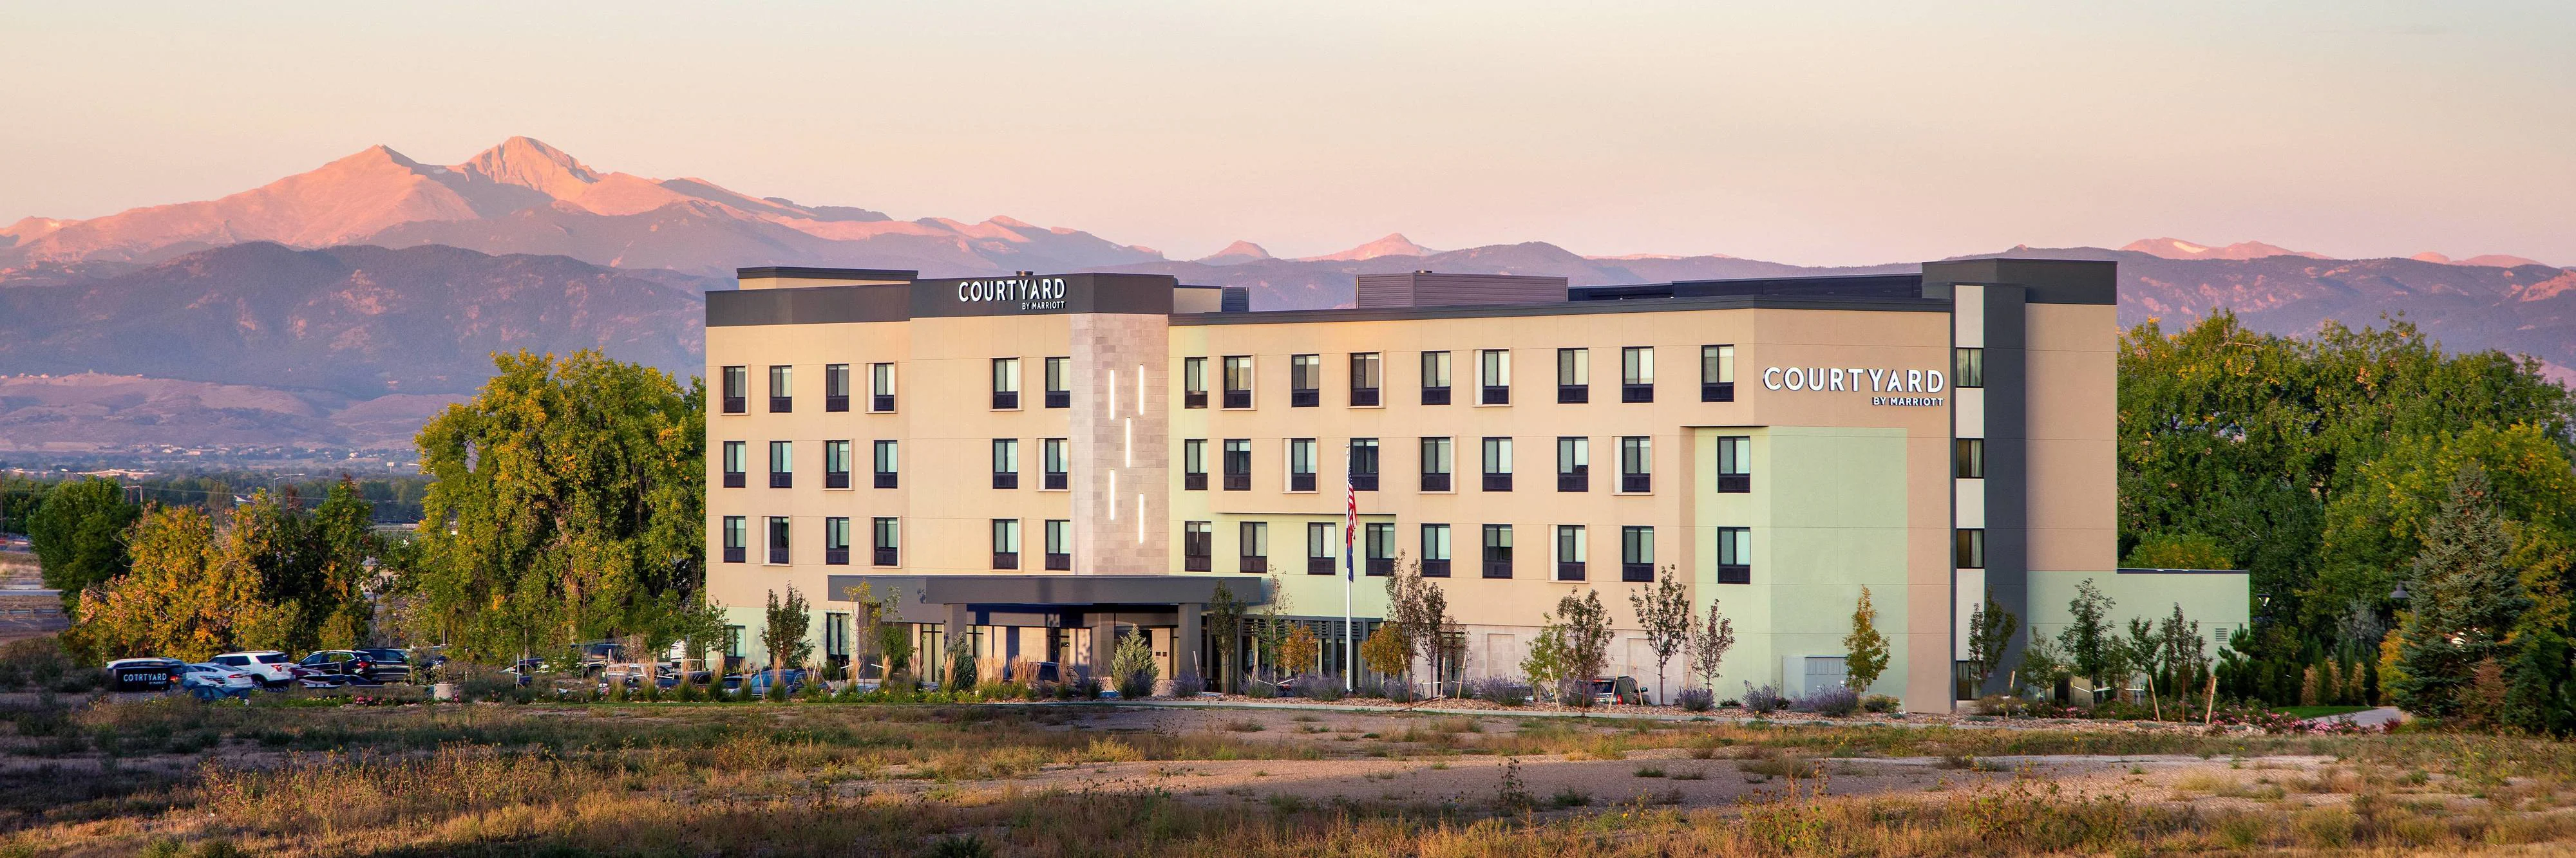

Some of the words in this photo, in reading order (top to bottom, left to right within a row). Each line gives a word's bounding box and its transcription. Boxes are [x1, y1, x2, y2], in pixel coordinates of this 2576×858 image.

[958, 278, 1066, 303] COURTYARD
[1032, 301, 1065, 310] MARRIOTT
[1763, 366, 1944, 393] COURTYARD
[1872, 396, 1886, 406] BY
[1889, 396, 1944, 406] MARRIOTT
